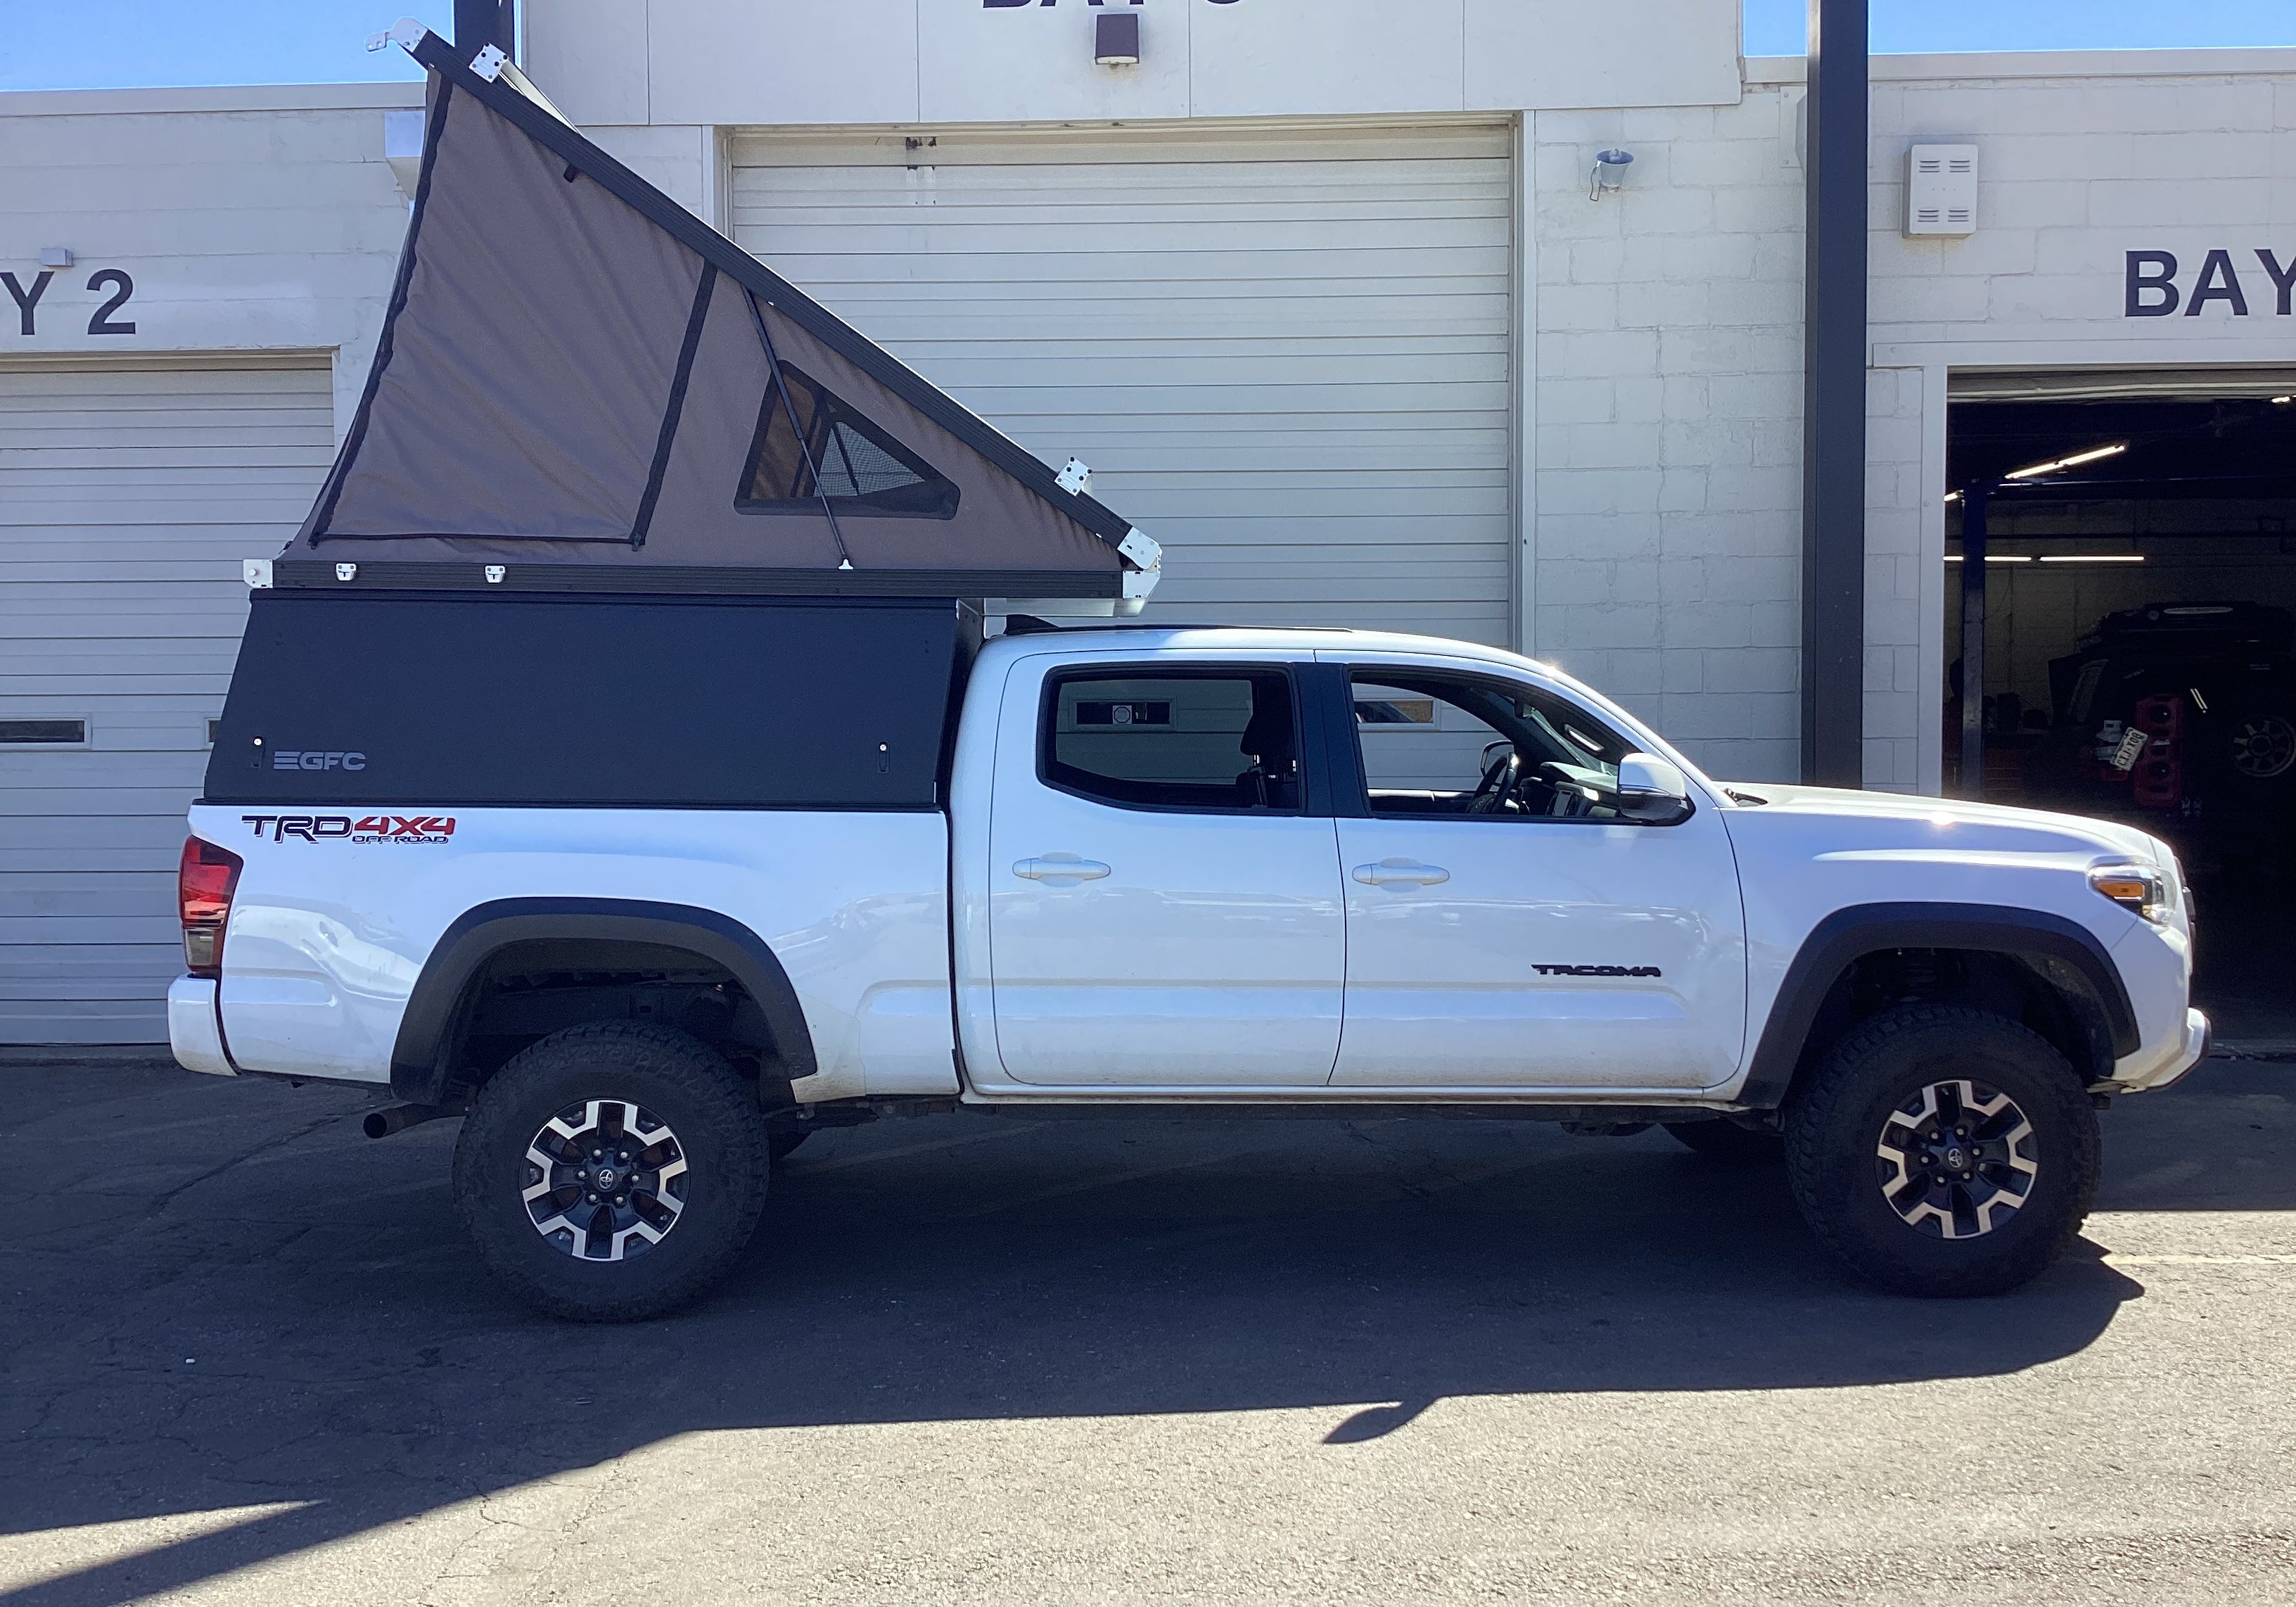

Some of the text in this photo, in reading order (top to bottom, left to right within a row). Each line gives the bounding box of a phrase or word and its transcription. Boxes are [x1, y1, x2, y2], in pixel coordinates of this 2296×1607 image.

[86, 269, 136, 335] 2
[2124, 249, 2296, 317] BAY
[352, 835, 449, 844] OFF ROAD
[1531, 964, 1662, 977] TACOMA
